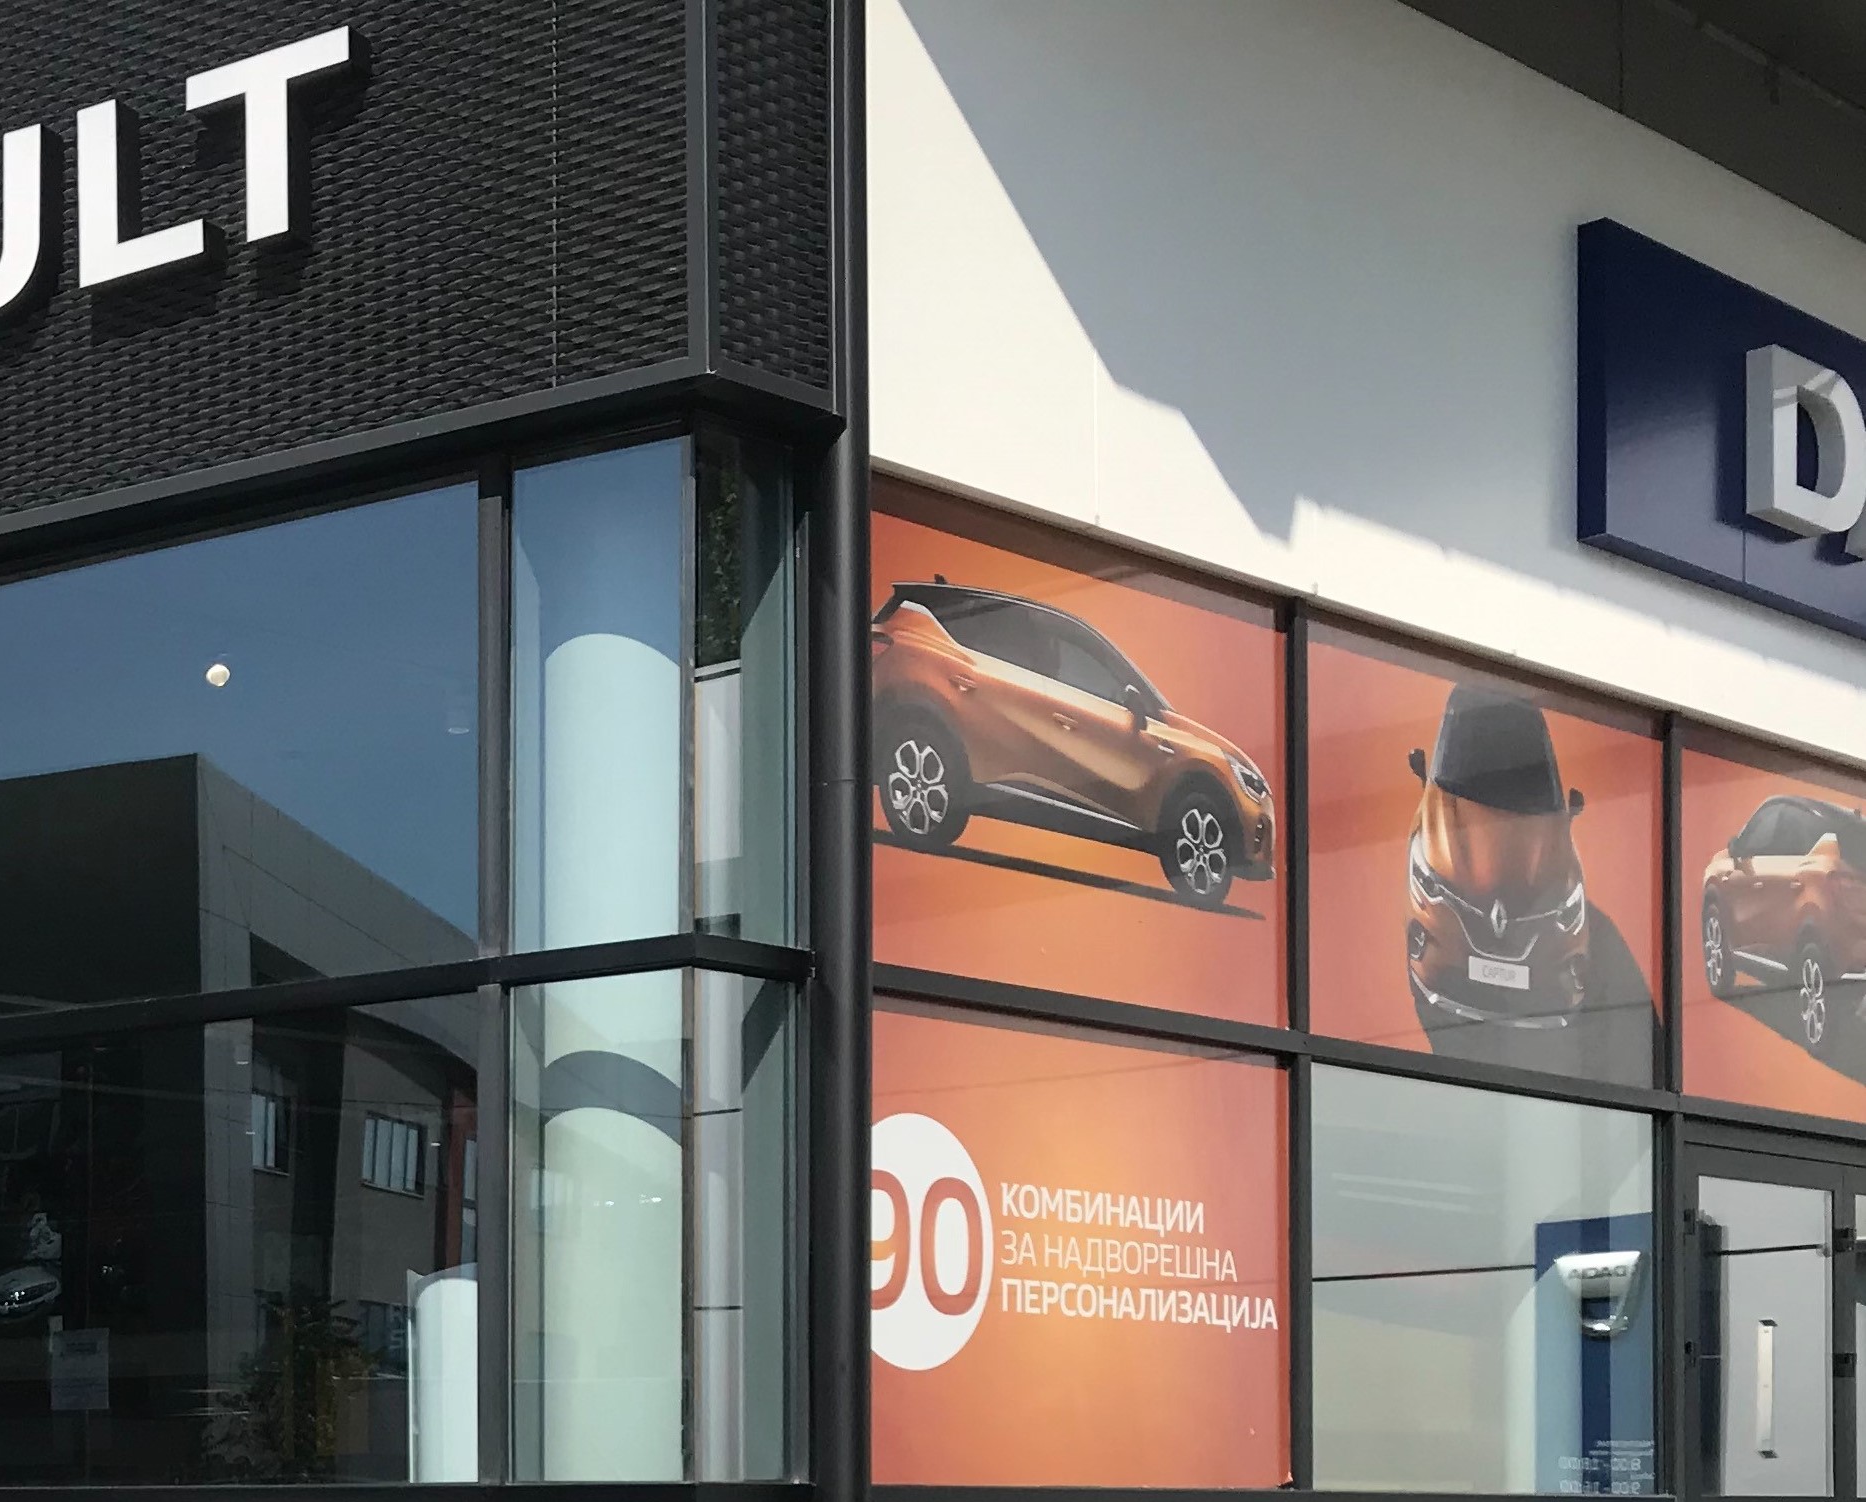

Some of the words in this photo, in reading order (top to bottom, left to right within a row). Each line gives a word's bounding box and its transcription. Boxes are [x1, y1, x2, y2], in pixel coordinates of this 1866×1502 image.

[1000, 1182, 1205, 1237] КОМБИНАЦИИ
[871, 1168, 984, 1316] 90
[1000, 1230, 1037, 1268] ЗА
[1044, 1234, 1238, 1283] НАДВОРЕШНА
[1000, 1277, 1278, 1333] ПЕРСОНАЛИЗАЦИЈА
